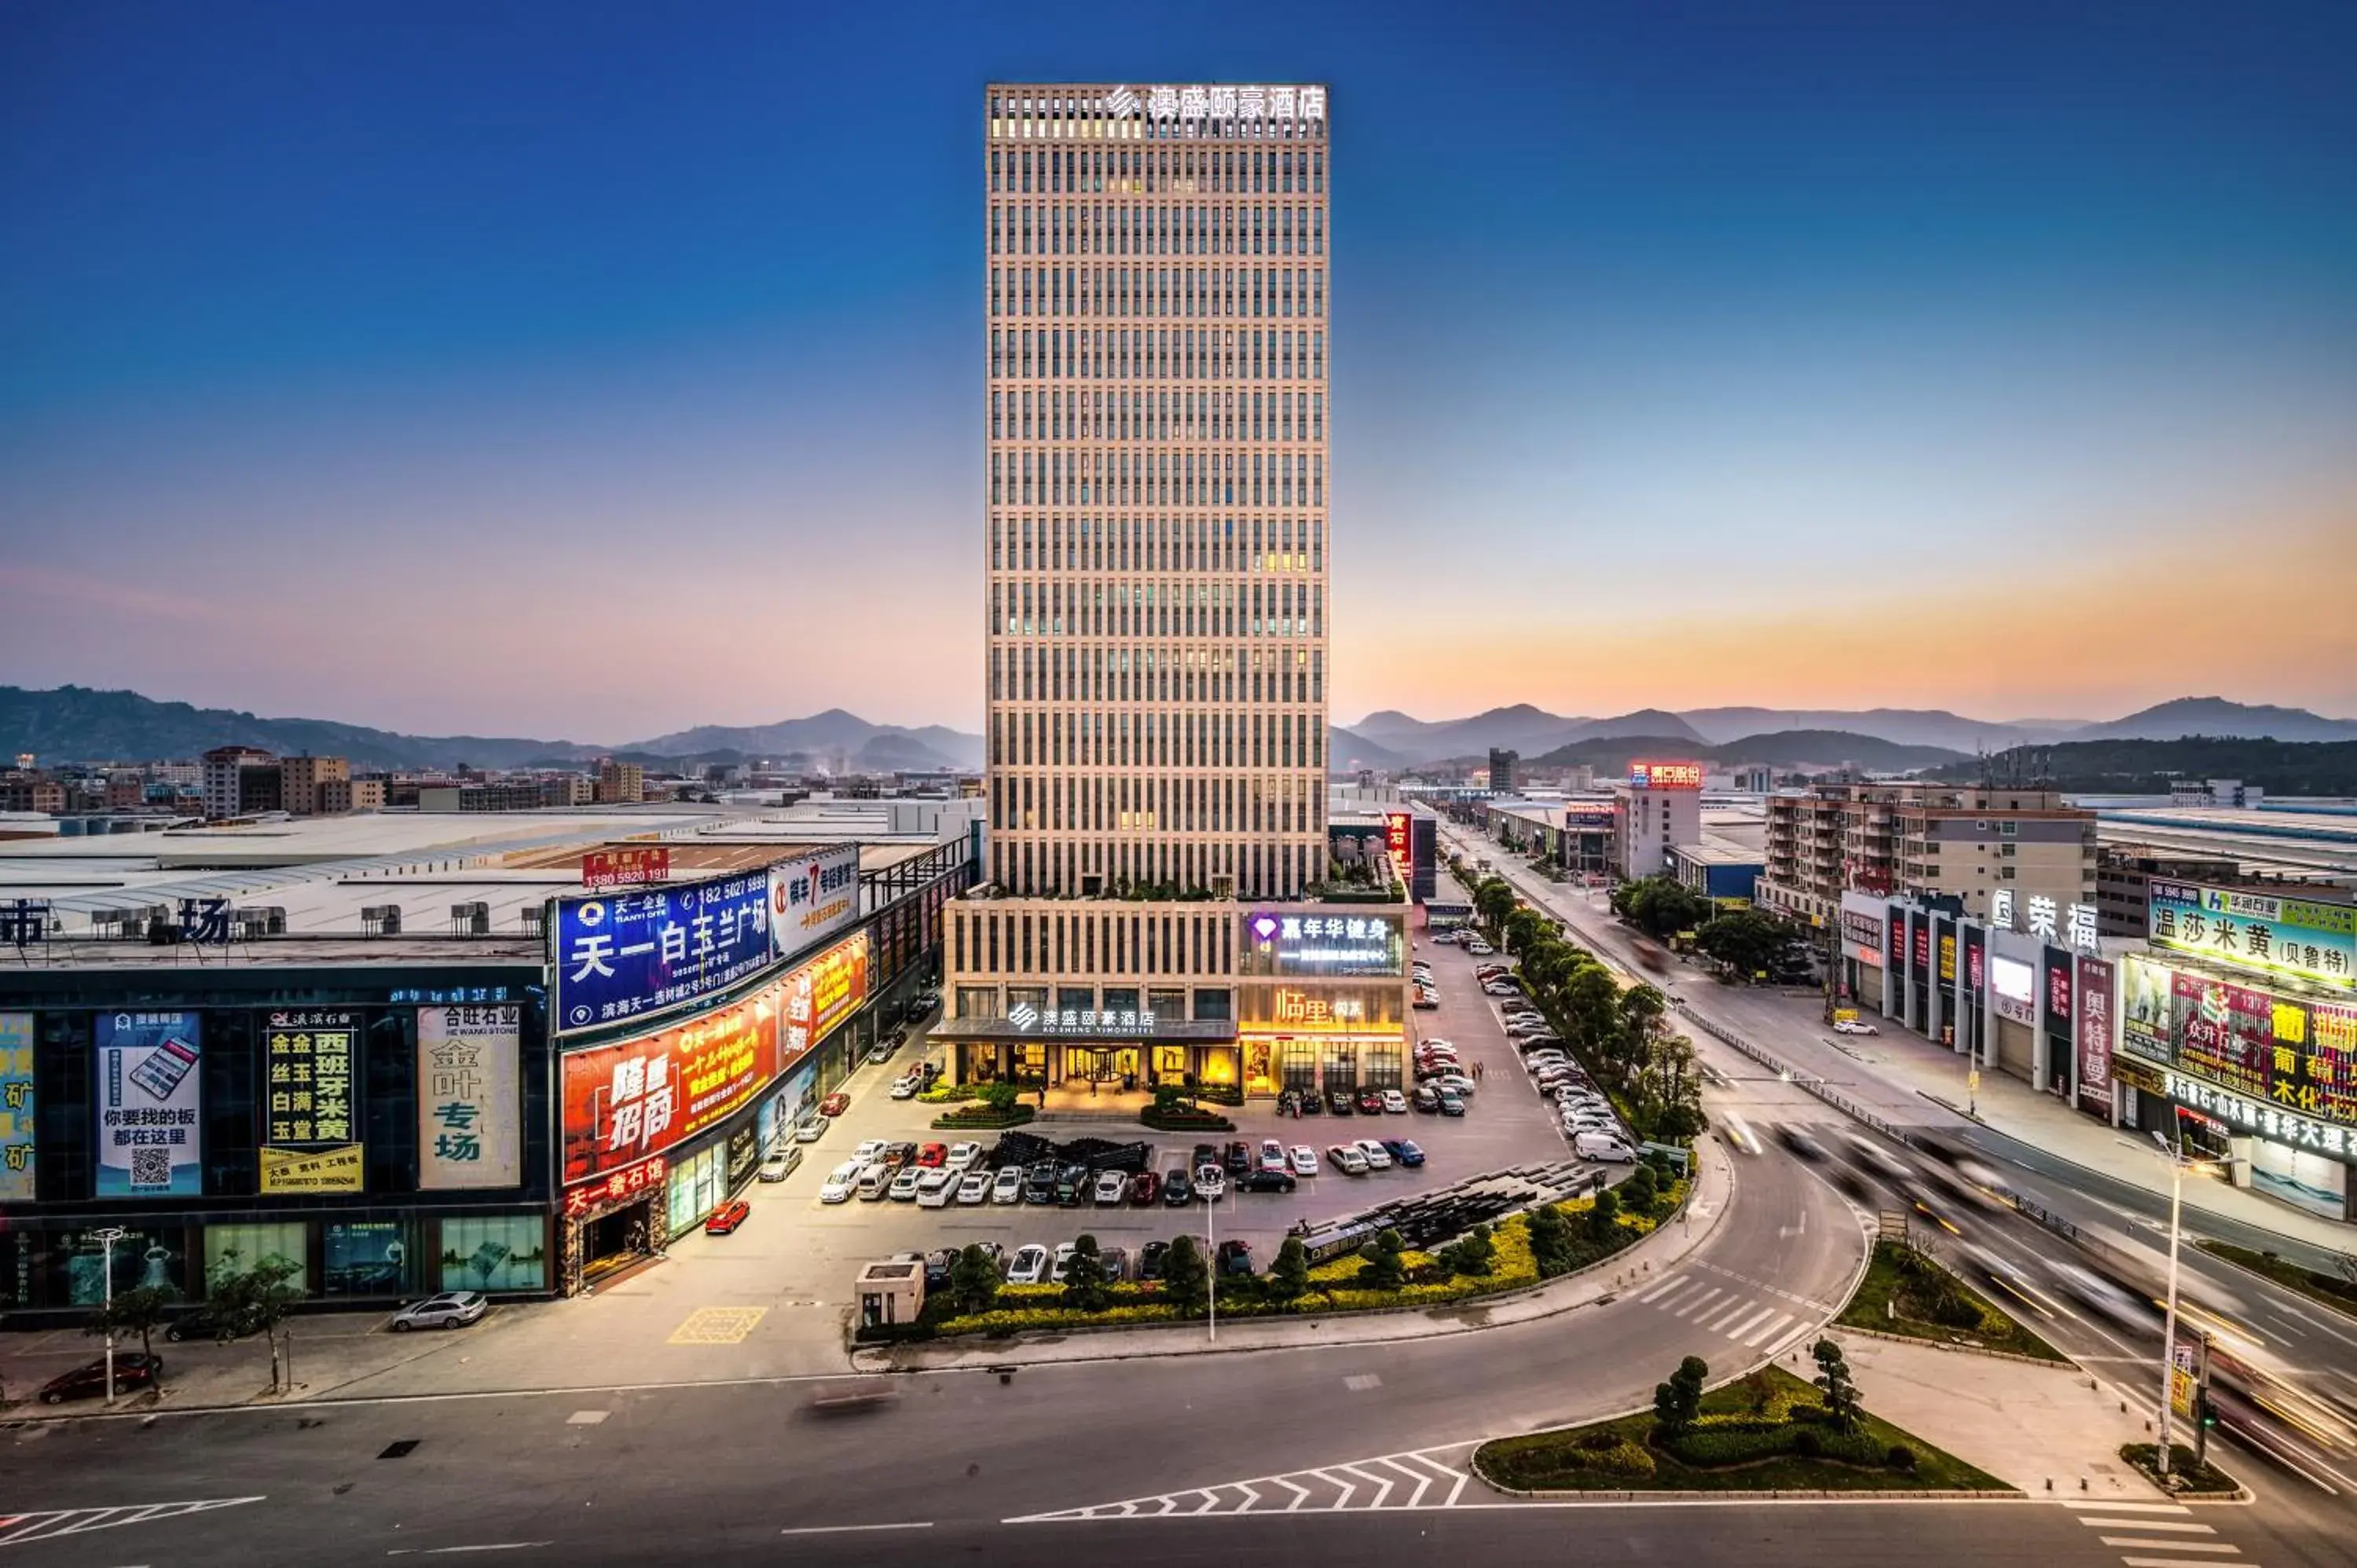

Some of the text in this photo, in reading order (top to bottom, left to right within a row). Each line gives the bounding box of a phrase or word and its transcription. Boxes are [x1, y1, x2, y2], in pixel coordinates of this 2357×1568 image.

[1150, 86, 1325, 119] 澳盛颐豪酒店
[586, 874, 615, 887] 1380
[618, 870, 645, 884] 5920
[648, 867, 667, 879] 191
[615, 894, 666, 914] 天一企业
[570, 898, 767, 983] 天一白玉兰广场
[1282, 918, 1388, 940] 嘉年华健身
[2155, 907, 2348, 974] 温莎米黄 (贝鲁特)
[445, 1006, 519, 1027] 合旺石业
[489, 1027, 519, 1035] STONE
[1043, 1010, 1156, 1026] 澳盛颐豪酒店
[271, 1033, 290, 1140] 金丝白玉
[292, 1033, 312, 1140] 金玉满堂
[315, 1033, 350, 1140] 西班牙米黄
[610, 1053, 669, 1108] 隆重
[104, 1108, 196, 1127] 你要找的板
[610, 1086, 673, 1152] 招商
[113, 1129, 187, 1145] 都在这里
[566, 1158, 665, 1214] 天一奢石馆
